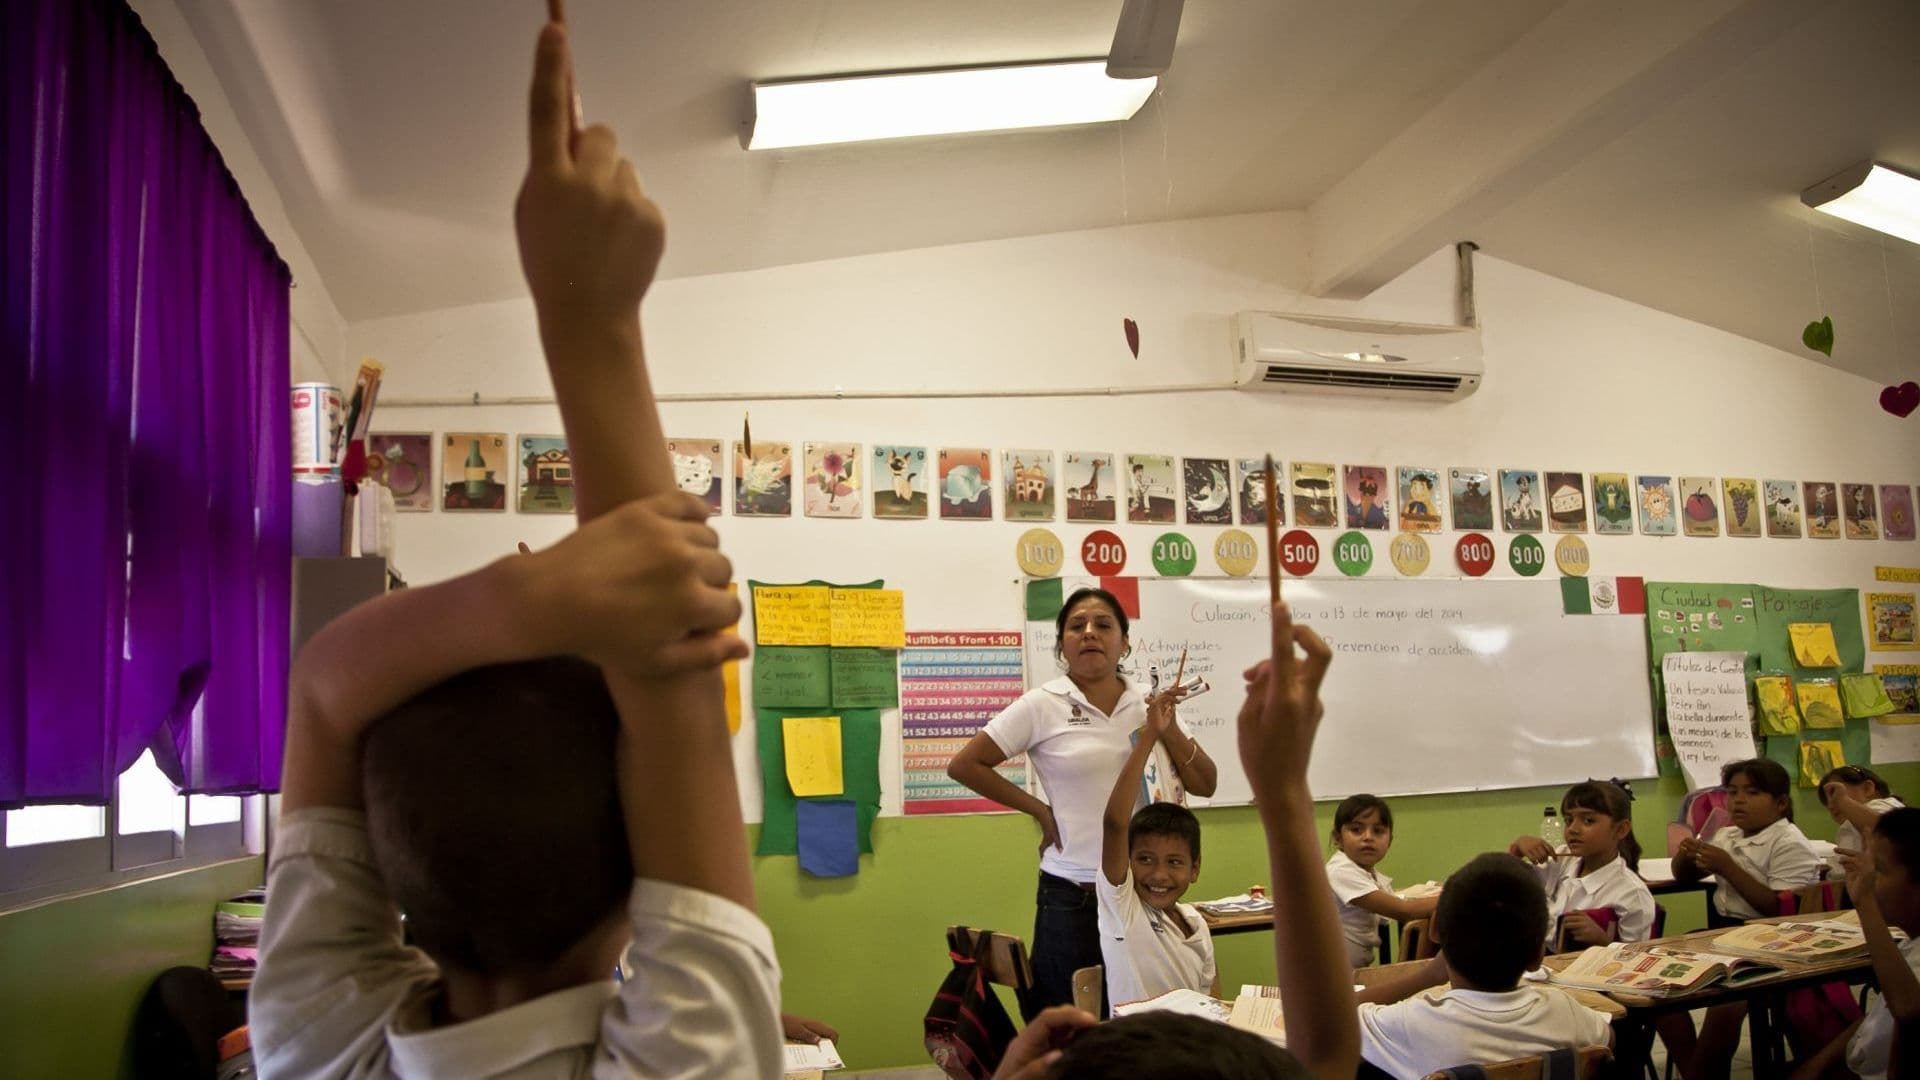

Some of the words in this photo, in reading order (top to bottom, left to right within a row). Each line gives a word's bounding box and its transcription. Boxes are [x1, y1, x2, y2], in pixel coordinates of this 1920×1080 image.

[1024, 542, 1058, 565] 100
[1086, 541, 1123, 564] 200
[1156, 541, 1192, 561] 300
[1219, 540, 1253, 560] 400
[1284, 543, 1316, 564] 500
[1340, 543, 1370, 562] 600
[1461, 542, 1491, 562] 800
[1512, 545, 1543, 565] 900
[1661, 587, 1712, 607] Ciudad
[1763, 588, 1833, 619] Paisajes
[1319, 610, 1329, 619] a
[1334, 607, 1345, 619] 13
[1352, 607, 1369, 619] de
[1376, 609, 1408, 622] mayo
[1415, 607, 1433, 619] del
[989, 635, 1019, 646] 1-100
[1136, 638, 1222, 653] Actividades
[1408, 642, 1425, 656] de
[1704, 659, 1718, 673] de
[903, 728, 914, 736] 51
[915, 728, 927, 736] 52
[928, 728, 939, 736] 53
[940, 728, 951, 736] 54
[952, 728, 964, 736] 55
[965, 728, 976, 736] 56
